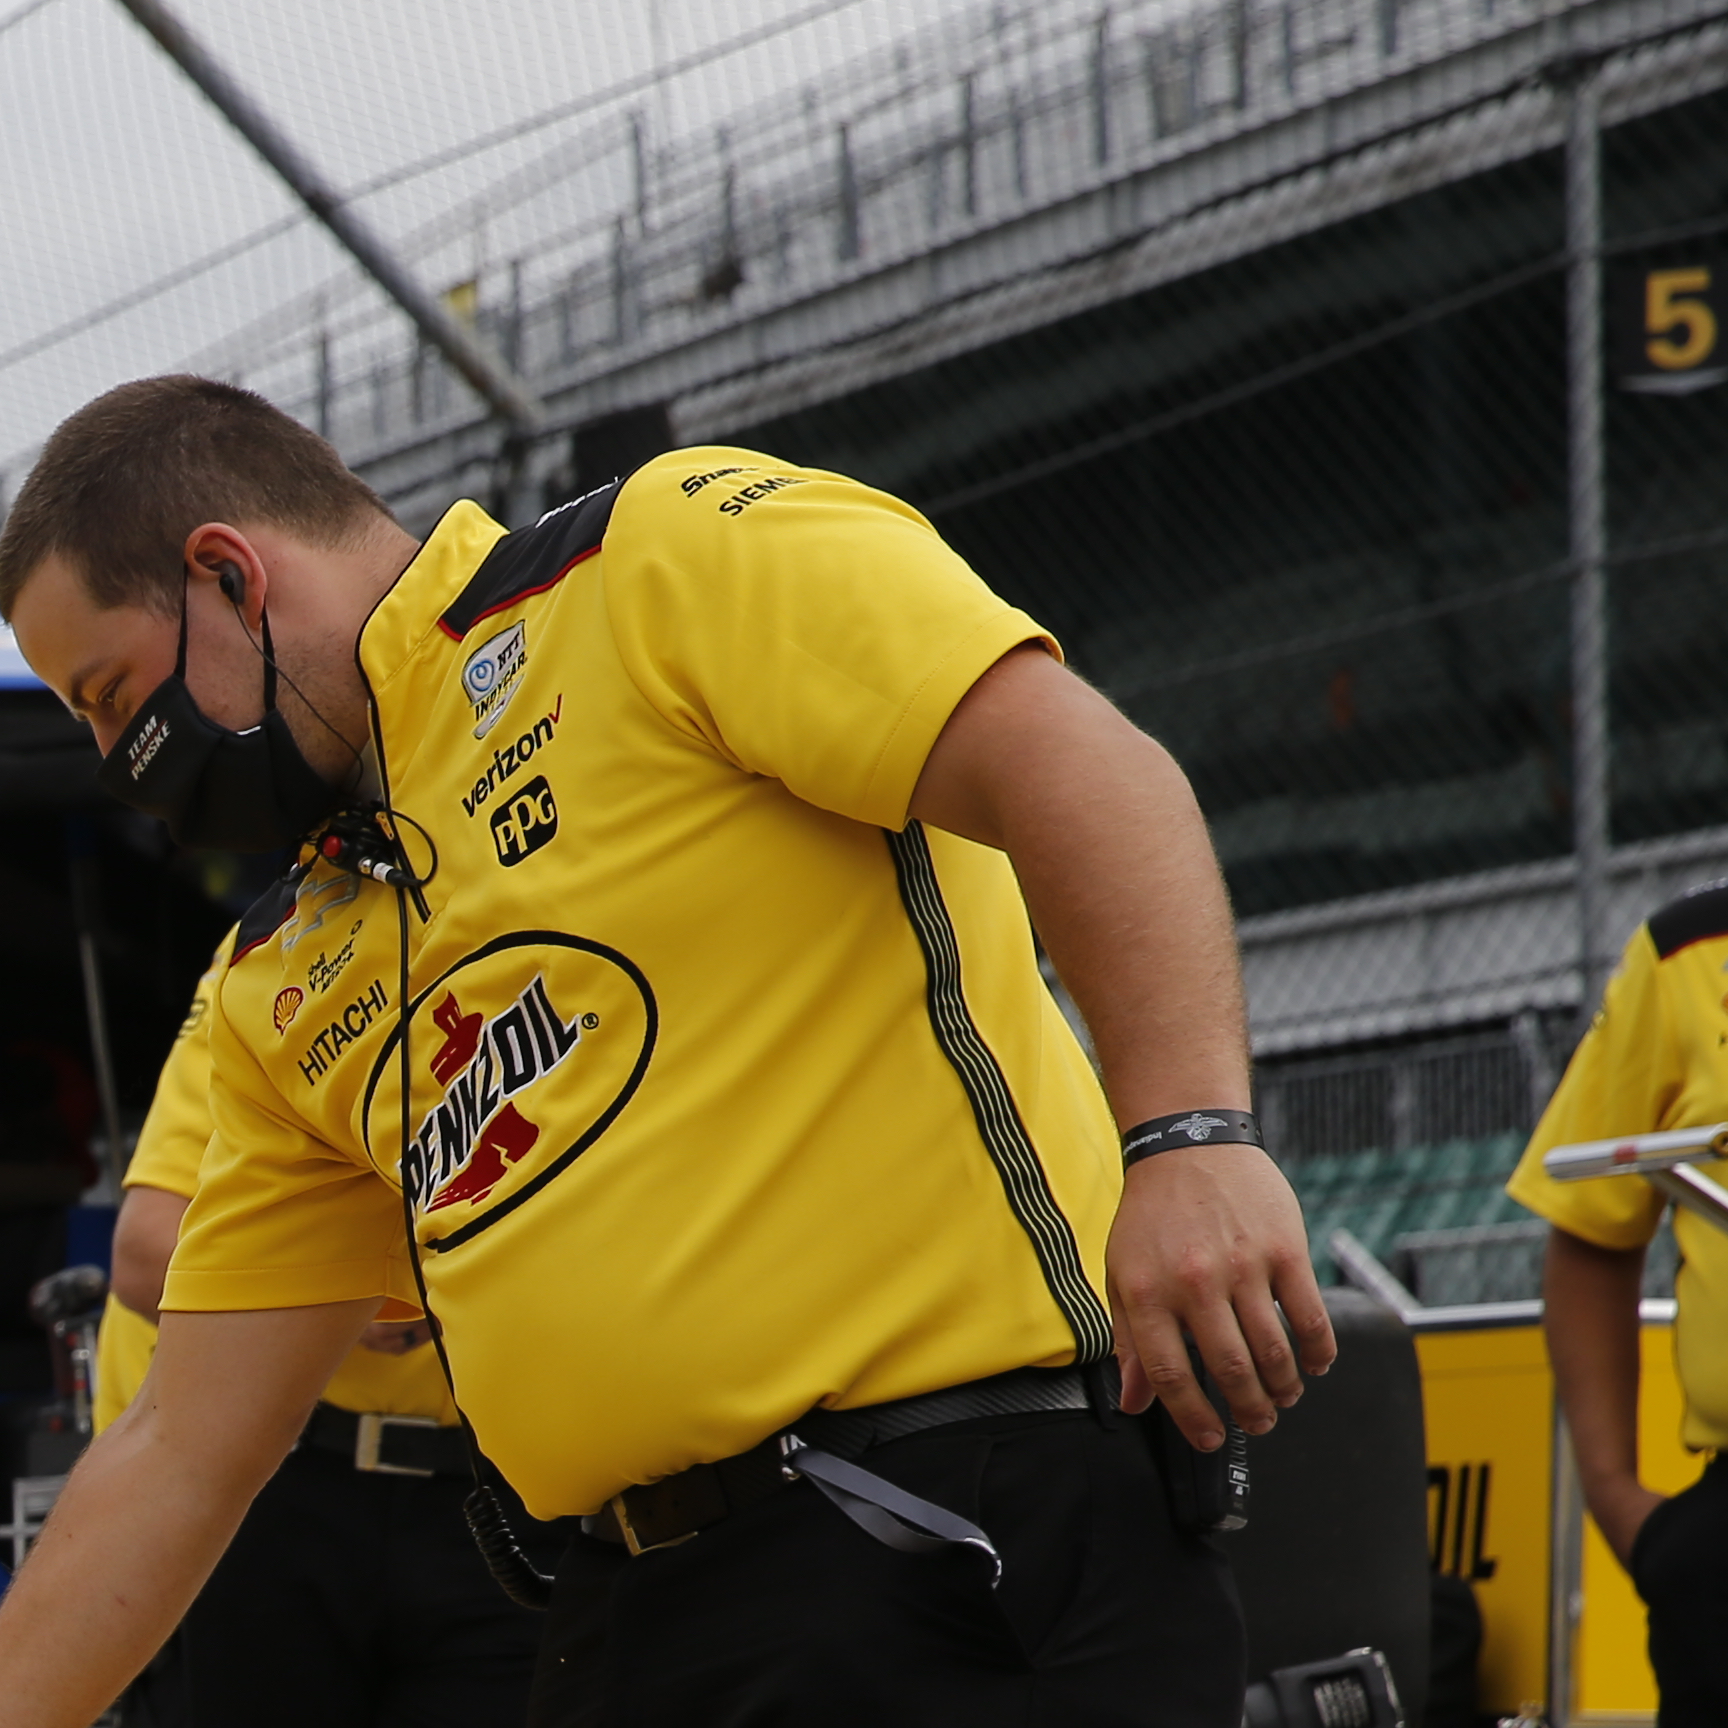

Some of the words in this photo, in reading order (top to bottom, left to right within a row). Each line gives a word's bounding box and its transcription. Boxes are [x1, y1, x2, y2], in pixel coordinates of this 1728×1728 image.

[1645, 267, 1718, 370] 5
[497, 631, 522, 671] NTT
[475, 652, 526, 721] INDYCAR
[127, 714, 157, 760] TEAM
[131, 720, 171, 781] PENSKE
[461, 717, 554, 818] verizon
[494, 788, 554, 857] PPG
[297, 978, 388, 1087] HITACHI
